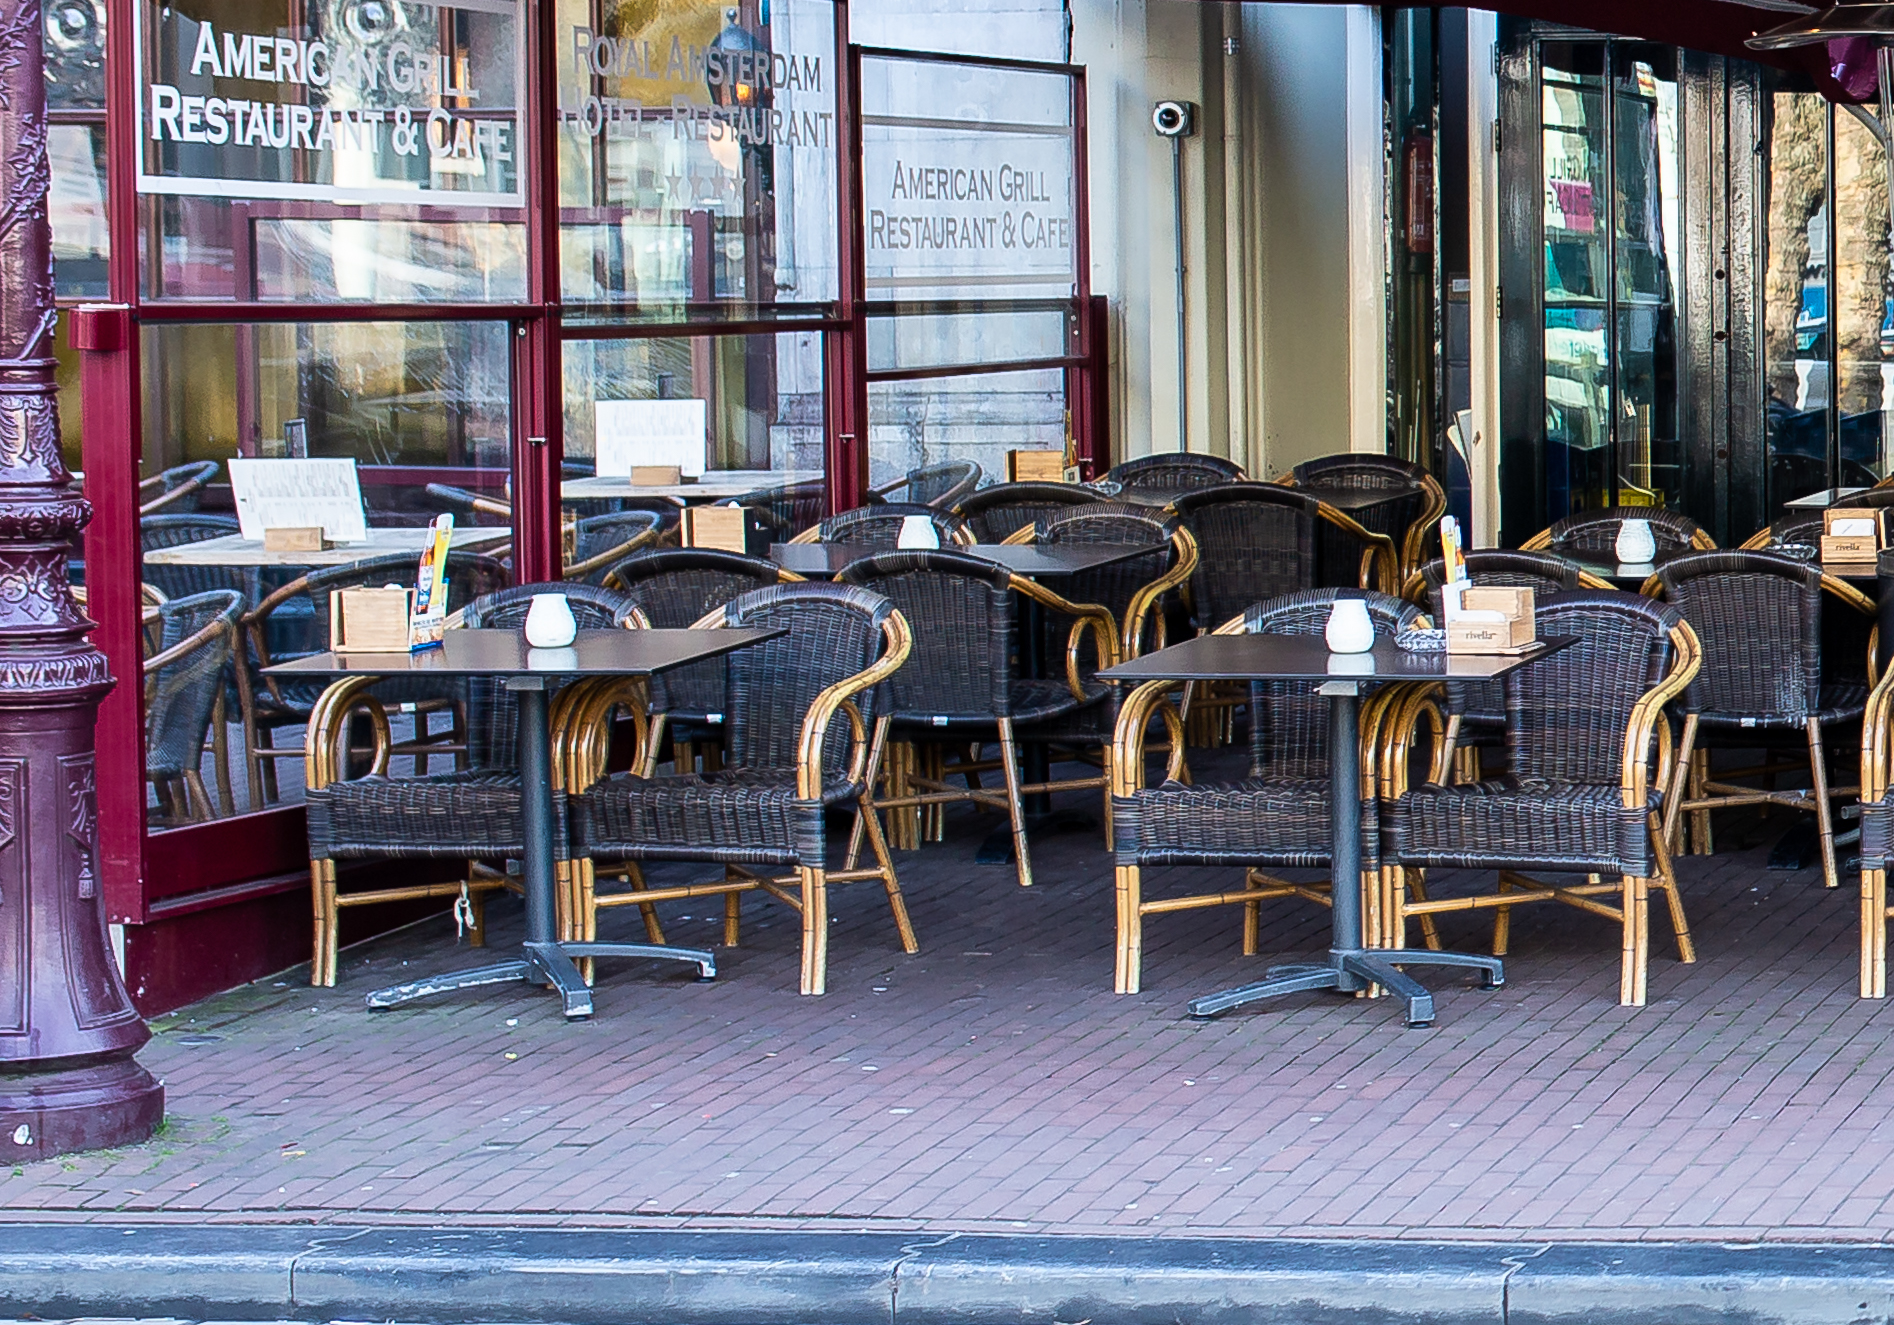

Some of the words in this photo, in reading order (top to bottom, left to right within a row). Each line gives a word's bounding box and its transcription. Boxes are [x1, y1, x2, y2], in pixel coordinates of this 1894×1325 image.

[190, 21, 379, 92] AMERICAN
[386, 41, 480, 100] GRILL
[572, 25, 659, 81] ROYAL
[666, 34, 822, 94] AMSTERDAM
[150, 83, 385, 153] RESTAURANT
[392, 103, 419, 157] &
[425, 107, 513, 163] CAFE
[559, 85, 649, 139] HOTEL
[671, 94, 833, 149] RESTAURANT
[891, 159, 993, 202] AMERICAN
[999, 163, 1051, 202] GRILL
[869, 208, 997, 250] RESTAURANT
[1001, 210, 1017, 249] &
[1020, 210, 1069, 249] CAFE
